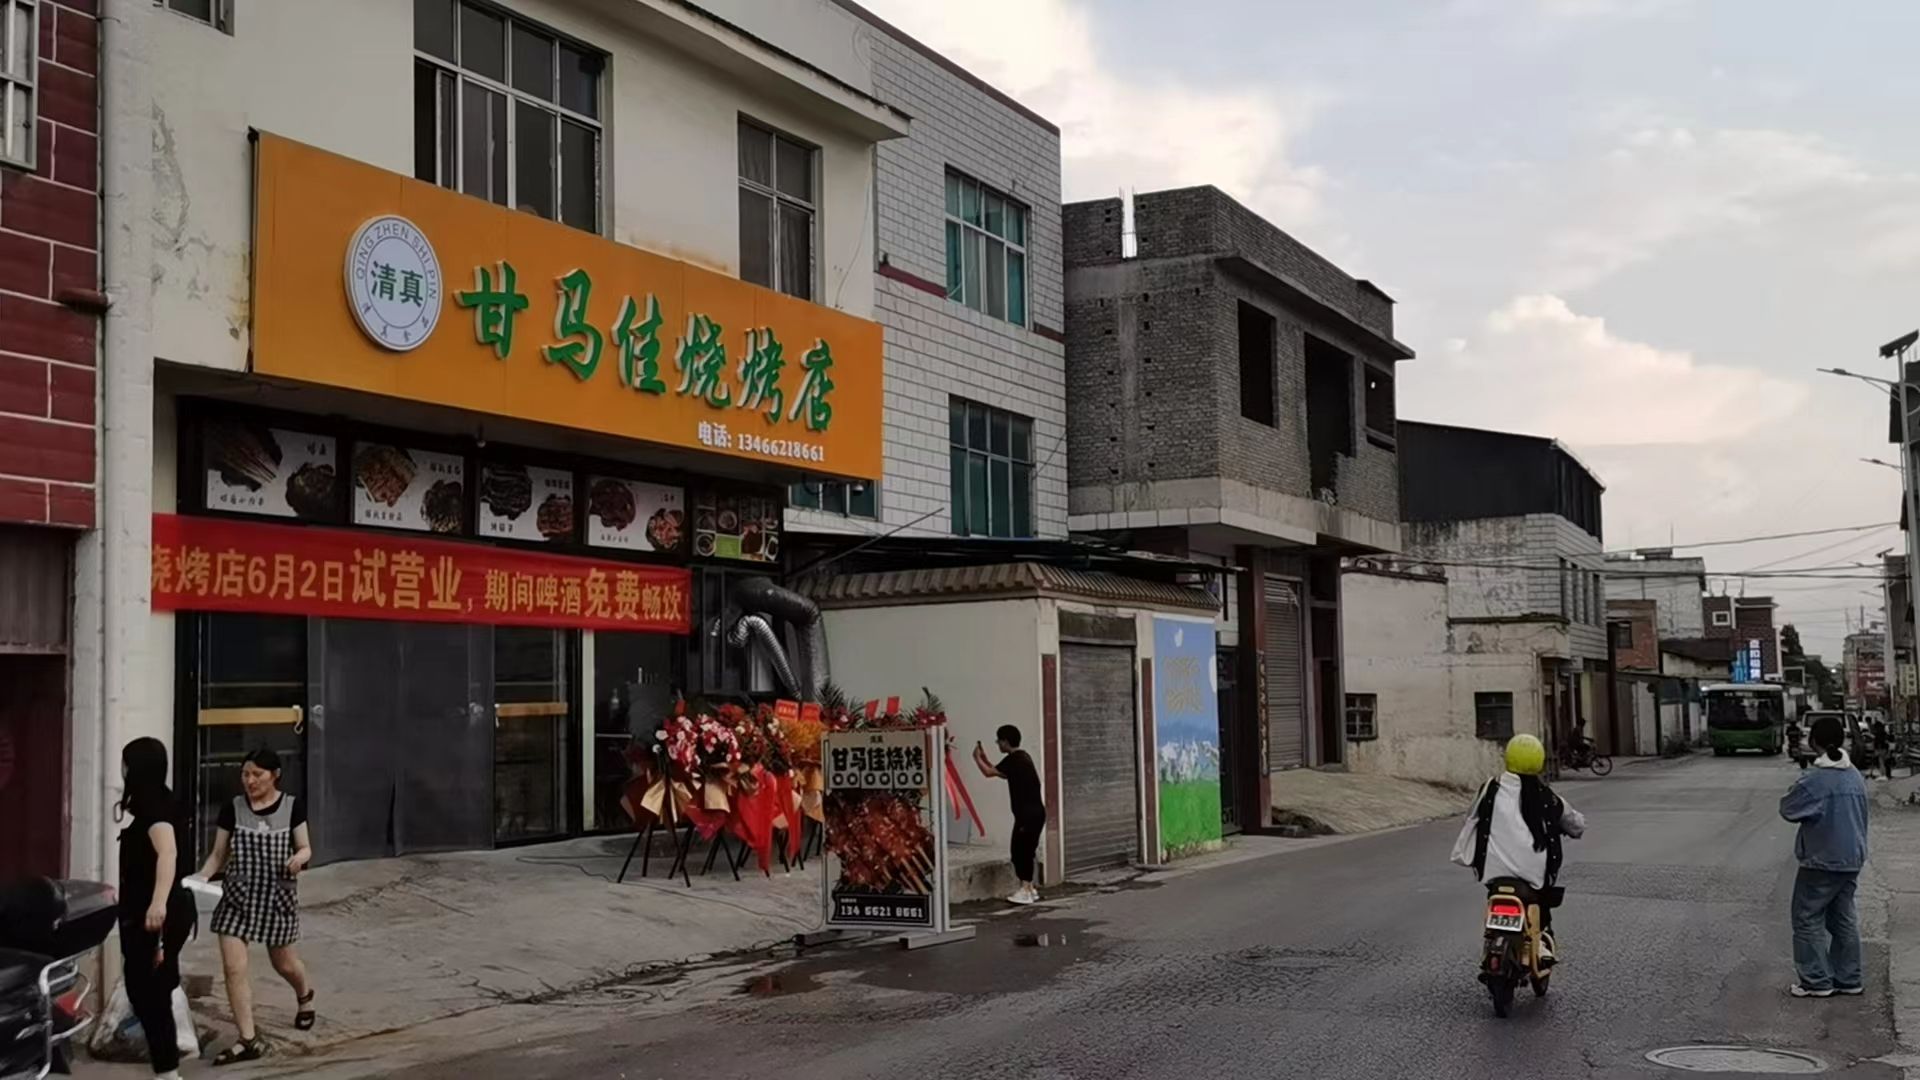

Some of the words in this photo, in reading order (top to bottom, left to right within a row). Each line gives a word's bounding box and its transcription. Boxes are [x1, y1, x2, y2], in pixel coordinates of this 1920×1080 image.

[355, 237, 374, 281] QING
[374, 223, 410, 240] ZHEN
[410, 235, 432, 264] SHI
[428, 269, 438, 301] PIN
[370, 260, 424, 308] 清真
[452, 260, 834, 432] 甘马佳烧烤店
[738, 433, 825, 462] 13466218661
[832, 745, 923, 771] 甘马佳烧烤
[840, 905, 860, 916] 134
